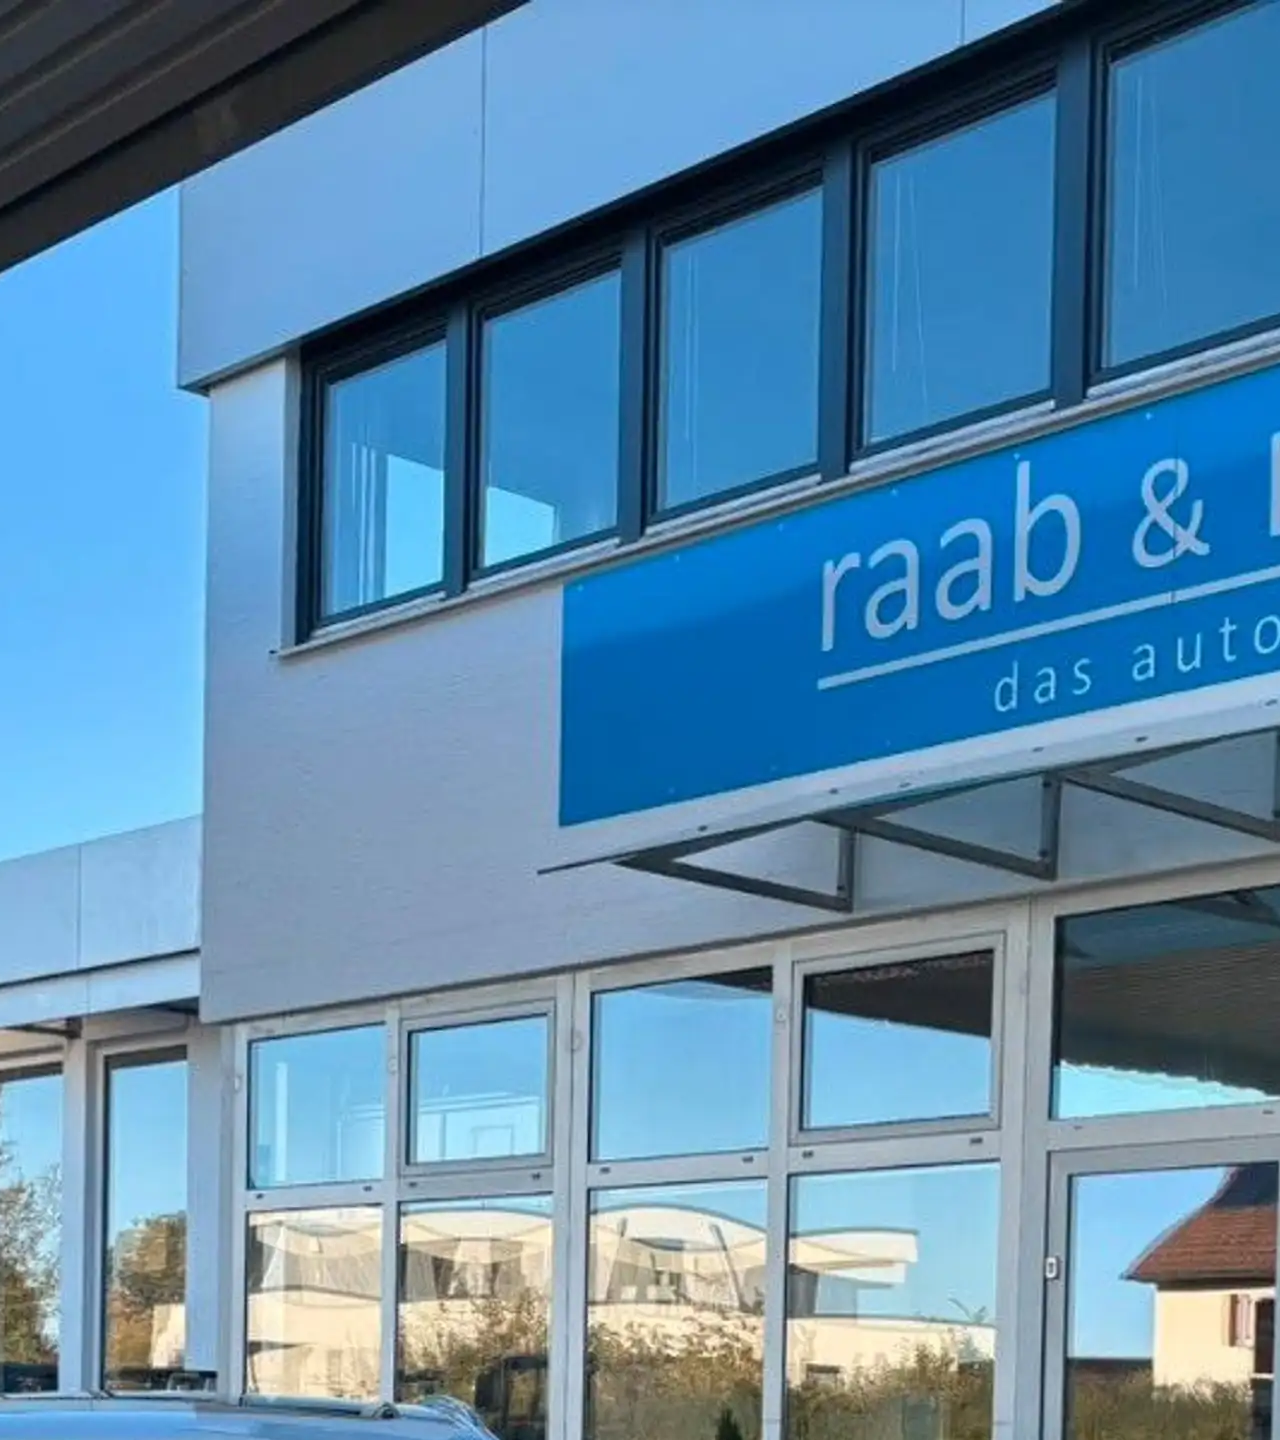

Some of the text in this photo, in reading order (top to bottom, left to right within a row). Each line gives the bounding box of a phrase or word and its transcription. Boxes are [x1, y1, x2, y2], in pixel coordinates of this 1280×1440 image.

[821, 459, 1080, 651] raab
[1131, 454, 1210, 570] &
[994, 653, 1095, 716] das
